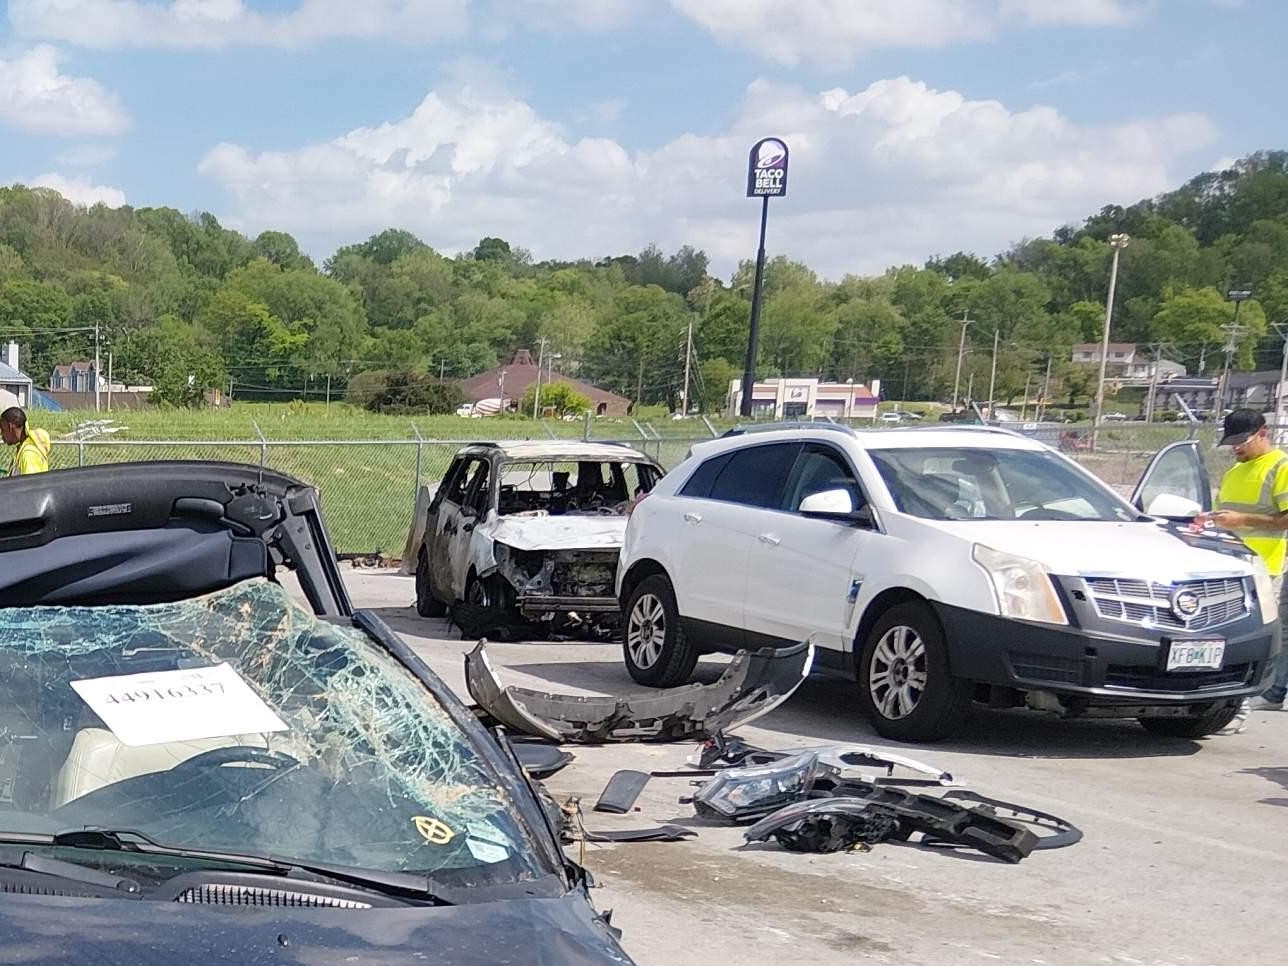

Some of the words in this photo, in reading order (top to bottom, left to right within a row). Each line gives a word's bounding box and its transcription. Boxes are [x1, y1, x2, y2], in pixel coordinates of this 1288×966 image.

[754, 168, 784, 179] TACO
[755, 178, 782, 188] BELL
[105, 682, 225, 705] 44916337
